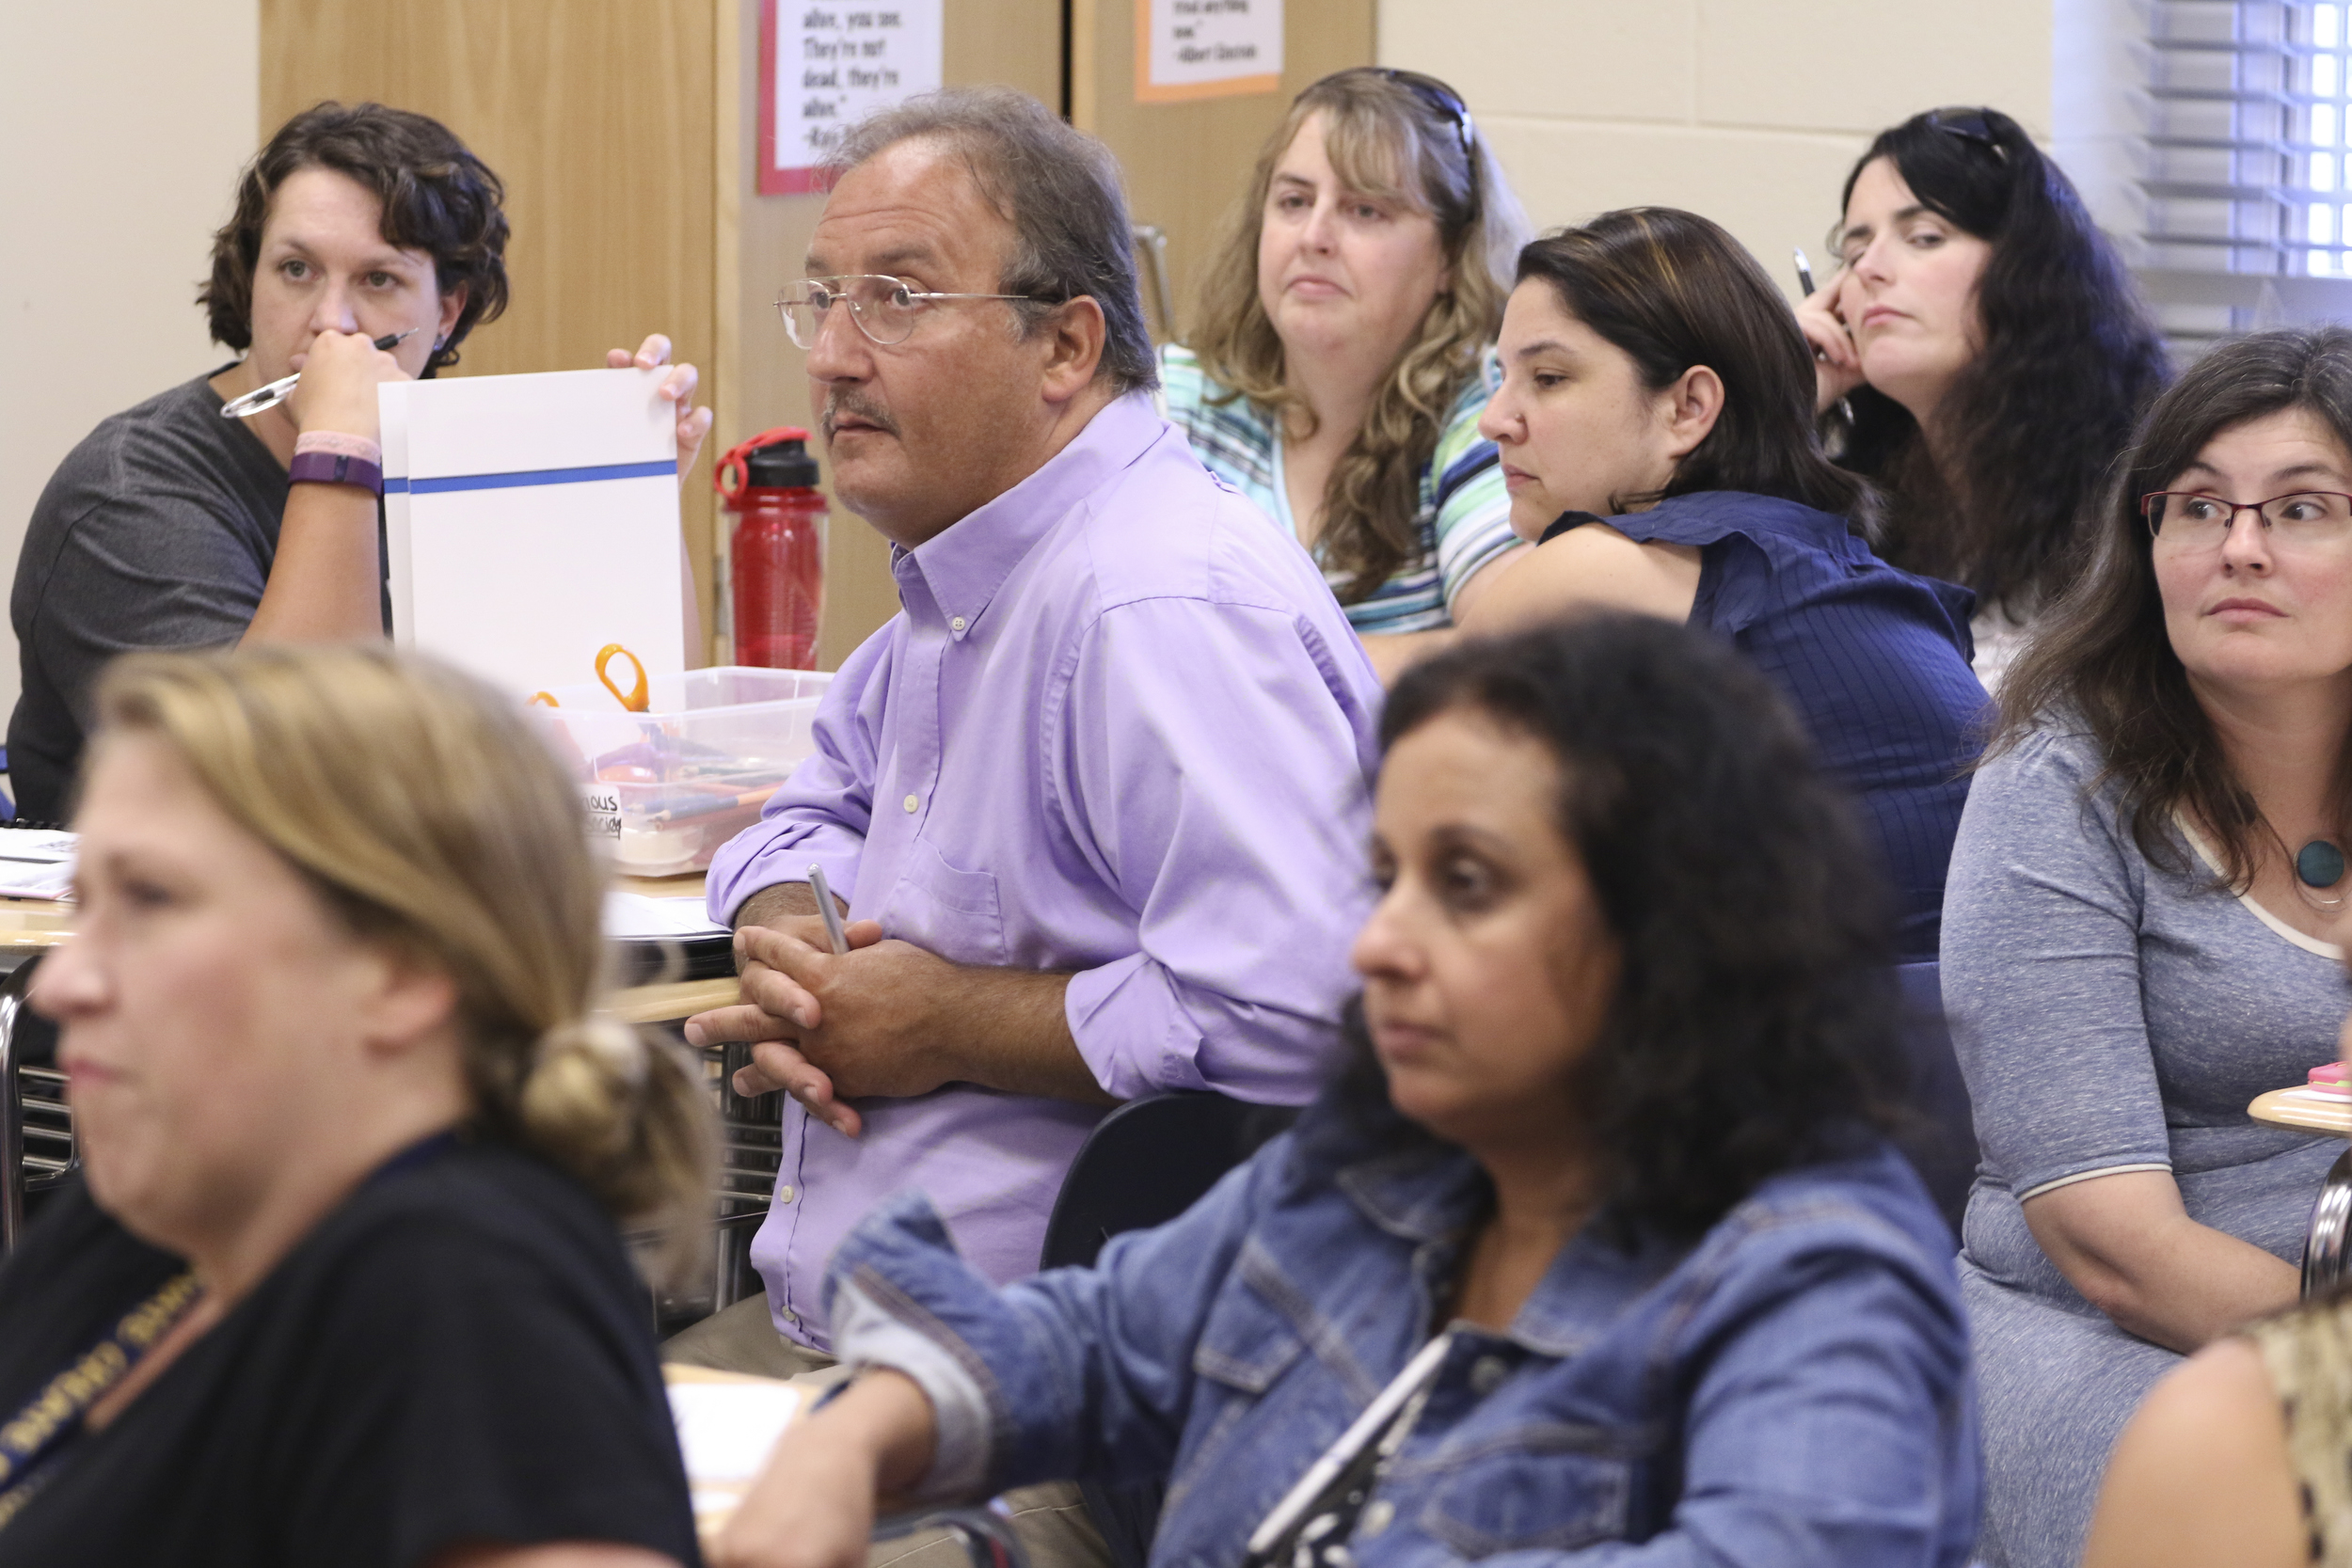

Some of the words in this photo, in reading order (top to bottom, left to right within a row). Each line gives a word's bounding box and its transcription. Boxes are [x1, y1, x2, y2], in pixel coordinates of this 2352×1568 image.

[848, 10, 872, 31] you
[803, 37, 857, 60] They're
[862, 40, 885, 57] not
